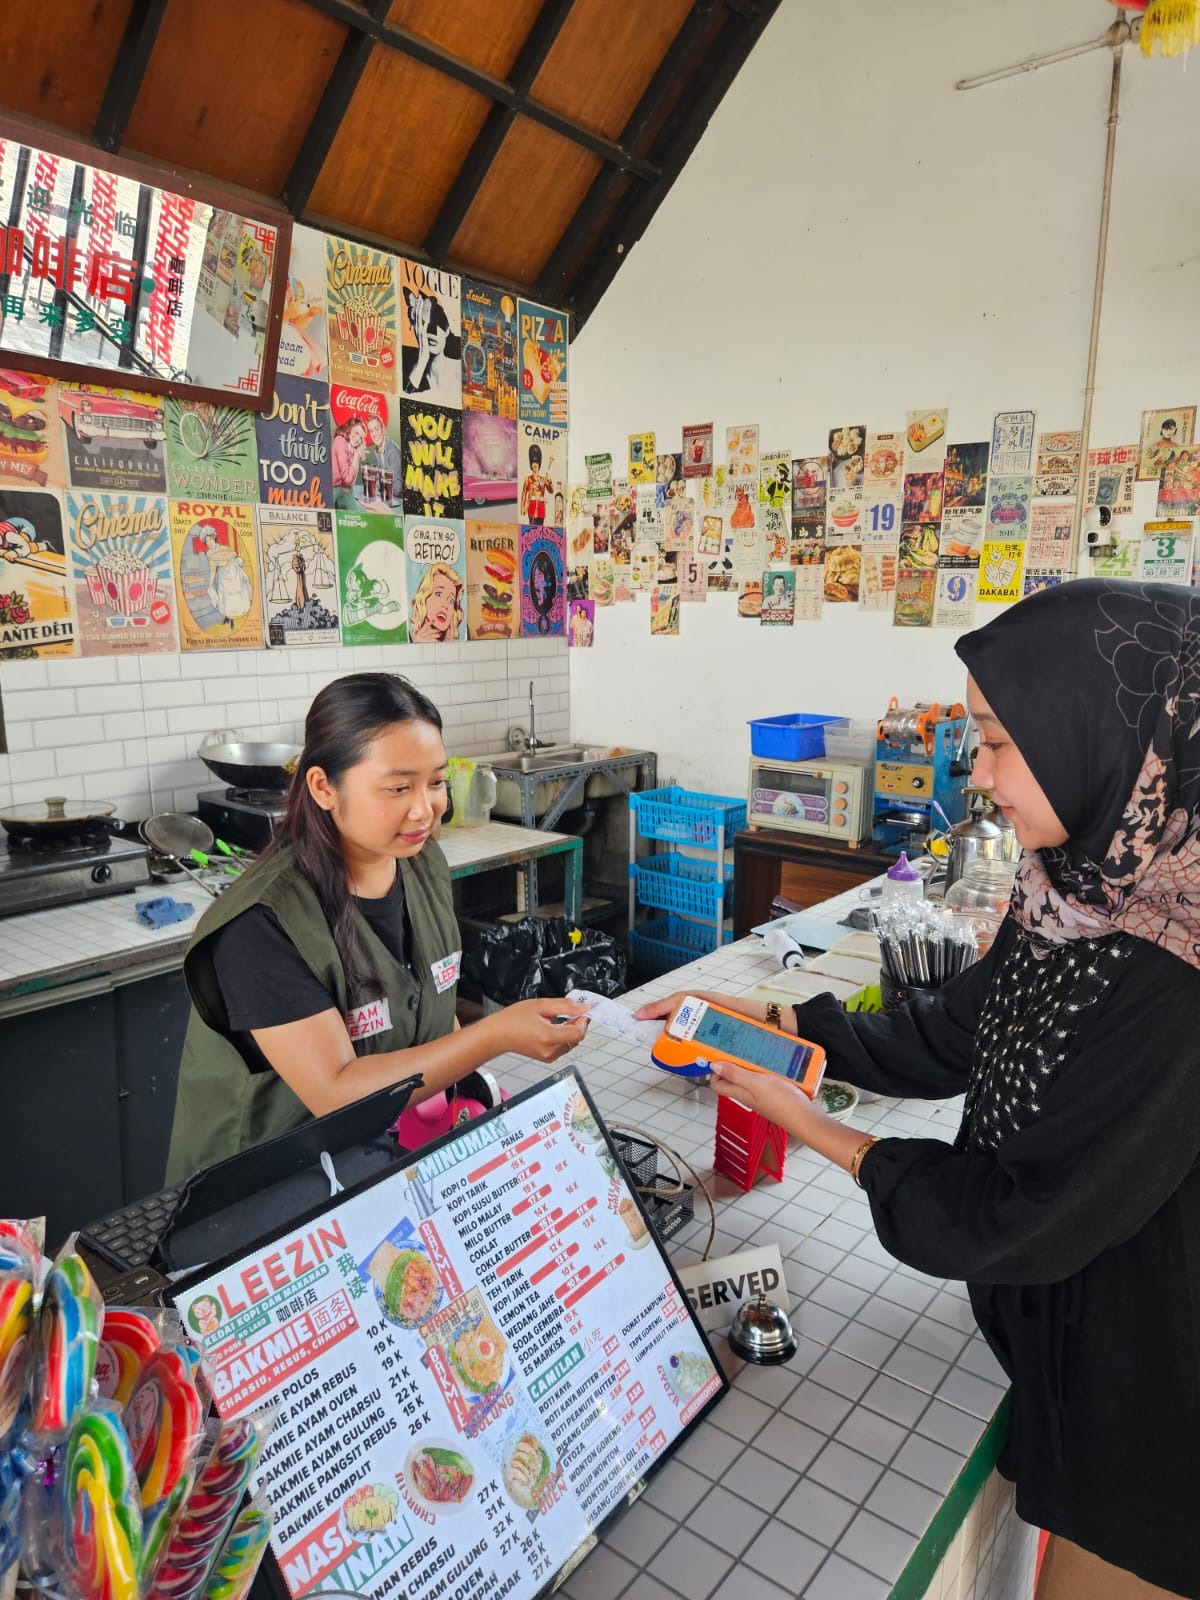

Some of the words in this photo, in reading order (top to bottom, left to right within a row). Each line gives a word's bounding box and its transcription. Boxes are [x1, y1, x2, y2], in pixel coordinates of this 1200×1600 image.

[330, 249, 391, 290] Cinema
[403, 260, 459, 299] VOGUE
[466, 289, 491, 306] London
[522, 315, 564, 343] PIZZA
[280, 427, 328, 464] think
[408, 413, 452, 442] YOU
[10, 463, 33, 475] ME!
[74, 455, 159, 472] CALIFORNIA
[260, 458, 307, 486] TOO
[408, 441, 454, 470] WILL
[173, 472, 257, 495] WONDER
[267, 477, 326, 508] much
[405, 465, 461, 500] MAKE
[74, 501, 162, 550] Cinema
[178, 501, 246, 519] ROYAL
[268, 511, 309, 523] BALANCE
[424, 502, 445, 518] IT
[870, 503, 895, 531] 19
[414, 542, 455, 561] RETRO!
[445, 532, 455, 541] SO
[470, 538, 514, 551] BURGER
[1157, 536, 1176, 558] 3
[688, 563, 698, 584] 5
[947, 575, 967, 602] 9
[980, 588, 1018, 597] DAKABA!
[42, 622, 73, 638] DĚTI
[501, 1129, 525, 1149] PANAS
[533, 1110, 556, 1130] DINGIN
[441, 1181, 461, 1200] KOPI
[461, 1177, 468, 1187] O
[447, 1193, 467, 1213] KOPI
[466, 1180, 489, 1202] TARIK
[452, 1206, 472, 1226] KOPI
[472, 1194, 492, 1213] SUSU
[493, 1177, 520, 1200] BUTTER
[458, 1221, 478, 1239] MILO
[478, 1203, 504, 1225] MALAY
[464, 1234, 484, 1252] MILO
[484, 1213, 513, 1238] BUTTER
[217, 1218, 348, 1318] LEEZIN
[469, 1237, 499, 1264] COKLAT
[475, 1249, 505, 1276] COKLAT
[505, 1230, 532, 1256] BUTTER
[336, 1252, 368, 1301] 我读
[480, 1271, 497, 1289] TEH
[486, 1284, 503, 1302] TEH
[502, 1268, 525, 1294] TARIK
[685, 1267, 780, 1312] SERVED
[204, 1321, 236, 1348] KEDAI
[236, 1308, 261, 1327] KOPI
[263, 1295, 283, 1312] DAN
[283, 1266, 328, 1300] MAKANAN
[276, 1288, 318, 1323] 咖啡店
[312, 1298, 348, 1330] 面条
[493, 1298, 512, 1315] KOPI
[512, 1279, 532, 1301] JAHE
[499, 1301, 526, 1328] LEMON
[526, 1290, 541, 1307] TEA
[621, 1313, 641, 1337] DONAT
[640, 1291, 667, 1321] KAMPUNG
[505, 1309, 539, 1340] WEDANG
[538, 1294, 556, 1315] JAHE
[512, 1331, 535, 1353] SODA
[533, 1305, 565, 1336] GEMBIRA
[628, 1333, 643, 1350] TAPE
[642, 1315, 663, 1339] GORENG
[215, 1314, 313, 1398] BAKMIE
[518, 1343, 540, 1365] SODA
[540, 1322, 564, 1348] LEMON
[523, 1364, 534, 1378] ES
[534, 1336, 566, 1368] MARKISA
[219, 1375, 271, 1413] CHARSIU,
[273, 1348, 311, 1377] REBUS,
[312, 1319, 347, 1350] CHASIU
[282, 1367, 320, 1401] POLOS
[529, 1345, 582, 1401] CAMILAN
[291, 1389, 322, 1419] AYAM
[324, 1362, 358, 1394] REBUS
[538, 1397, 556, 1415] ROTI
[555, 1380, 572, 1401] KAYA
[544, 1410, 561, 1428] ROTI
[560, 1394, 578, 1416] KAYA
[576, 1372, 600, 1398] BUTTER
[551, 1423, 567, 1442] ROTI
[566, 1397, 596, 1427] PEANUTE
[594, 1373, 617, 1399] BUTTER
[256, 1431, 296, 1469] AKMIE
[297, 1409, 329, 1438] AYAM
[329, 1383, 358, 1412] OVEN
[304, 1424, 336, 1455] AYAM
[336, 1388, 382, 1430] CHARSIU
[312, 1442, 343, 1472] AYAM
[342, 1406, 386, 1446] GULUNG
[318, 1444, 363, 1489] PANGSIT
[363, 1417, 398, 1450] REBUS
[556, 1428, 582, 1456] PISANG
[563, 1442, 586, 1468] GYOZA
[568, 1449, 598, 1483] WONTON
[596, 1424, 622, 1454] GORENG
[575, 1474, 593, 1497] SOUP
[592, 1445, 621, 1479] WONTON
[633, 1451, 651, 1472] KAYA
[278, 1501, 325, 1544] BAKMIE
[325, 1460, 372, 1506] KOMPLIT
[580, 1477, 609, 1512] WONTON
[283, 1520, 354, 1594] NASI
[400, 1536, 438, 1576] REBUS
[409, 1543, 456, 1596] CHARSIU
[446, 1537, 489, 1585] GULUNG
